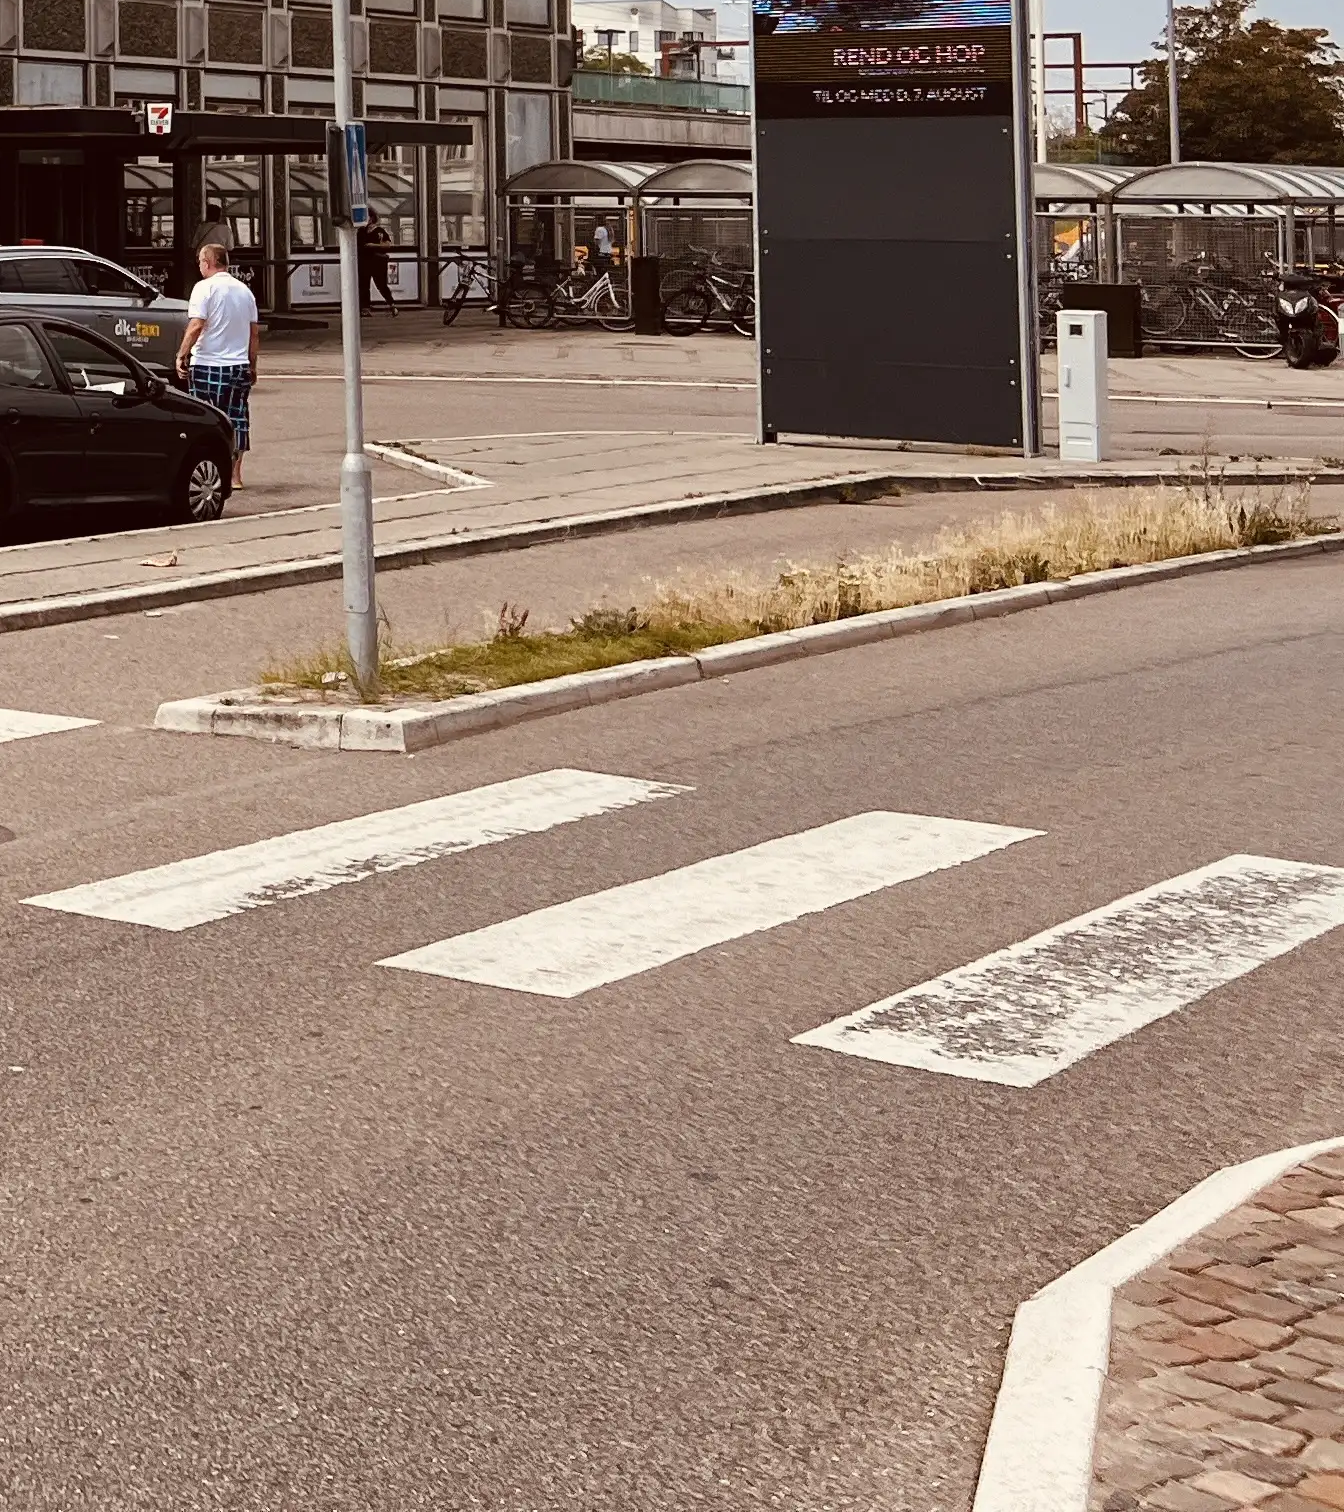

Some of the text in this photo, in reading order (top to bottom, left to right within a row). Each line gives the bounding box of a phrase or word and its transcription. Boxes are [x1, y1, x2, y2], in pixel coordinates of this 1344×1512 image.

[833, 44, 986, 65] REND OG HOP
[812, 90, 834, 103] TIL
